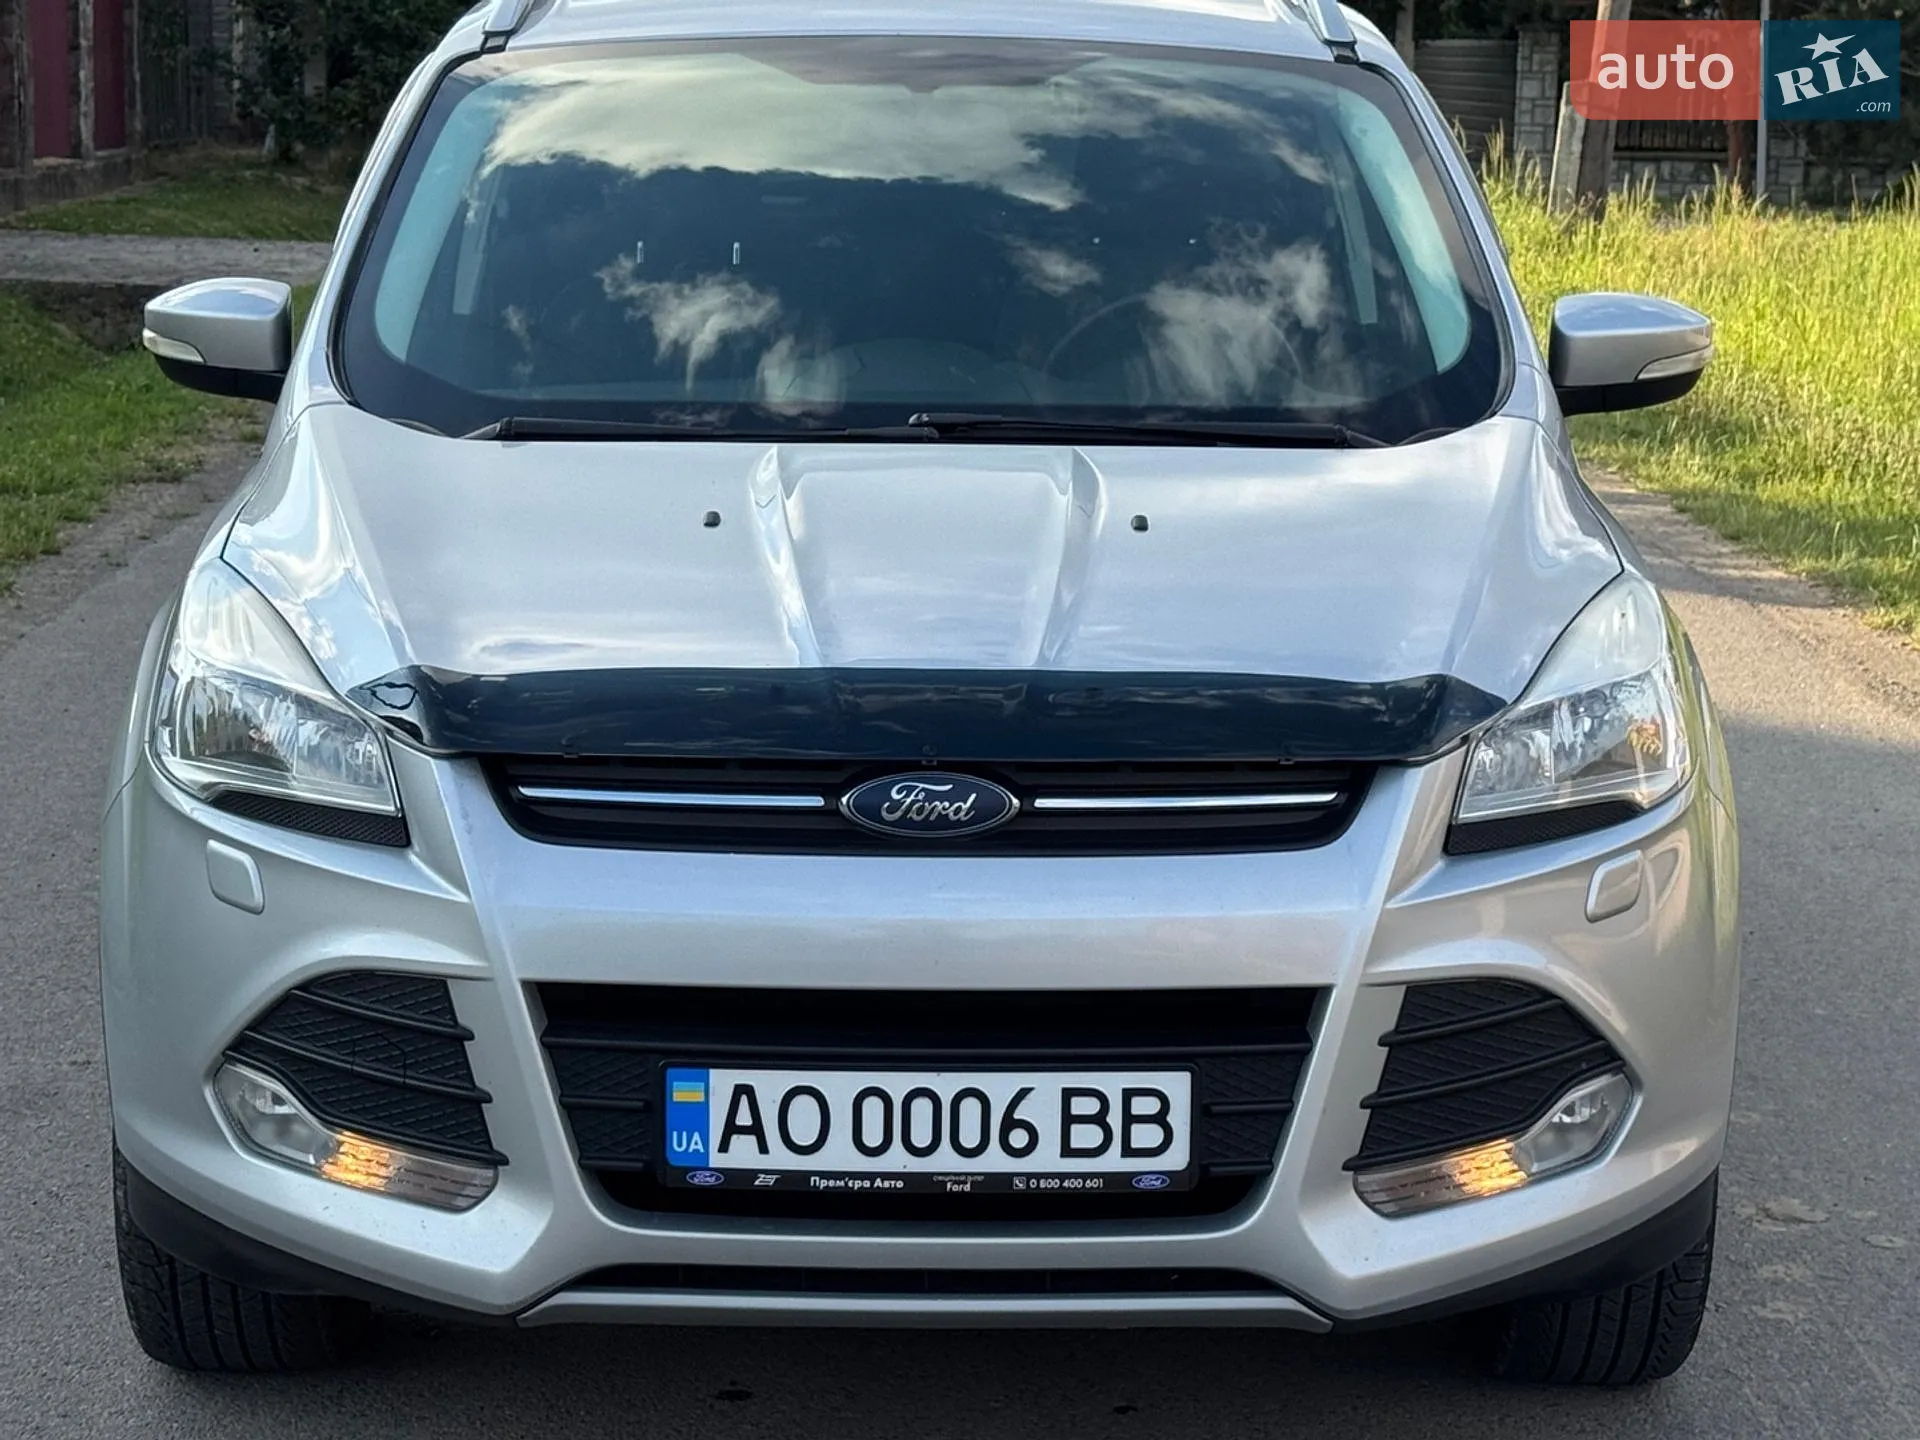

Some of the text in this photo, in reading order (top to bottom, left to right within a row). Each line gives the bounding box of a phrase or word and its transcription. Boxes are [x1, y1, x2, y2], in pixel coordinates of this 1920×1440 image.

[880, 781, 978, 822] Ford
[717, 1083, 1174, 1159] AO 0006 BB
[672, 1131, 705, 1154] UA
[873, 1178, 904, 1188] Авто
[946, 1181, 971, 1192] Ford
[1029, 1178, 1103, 1189] 0 800 400 601
